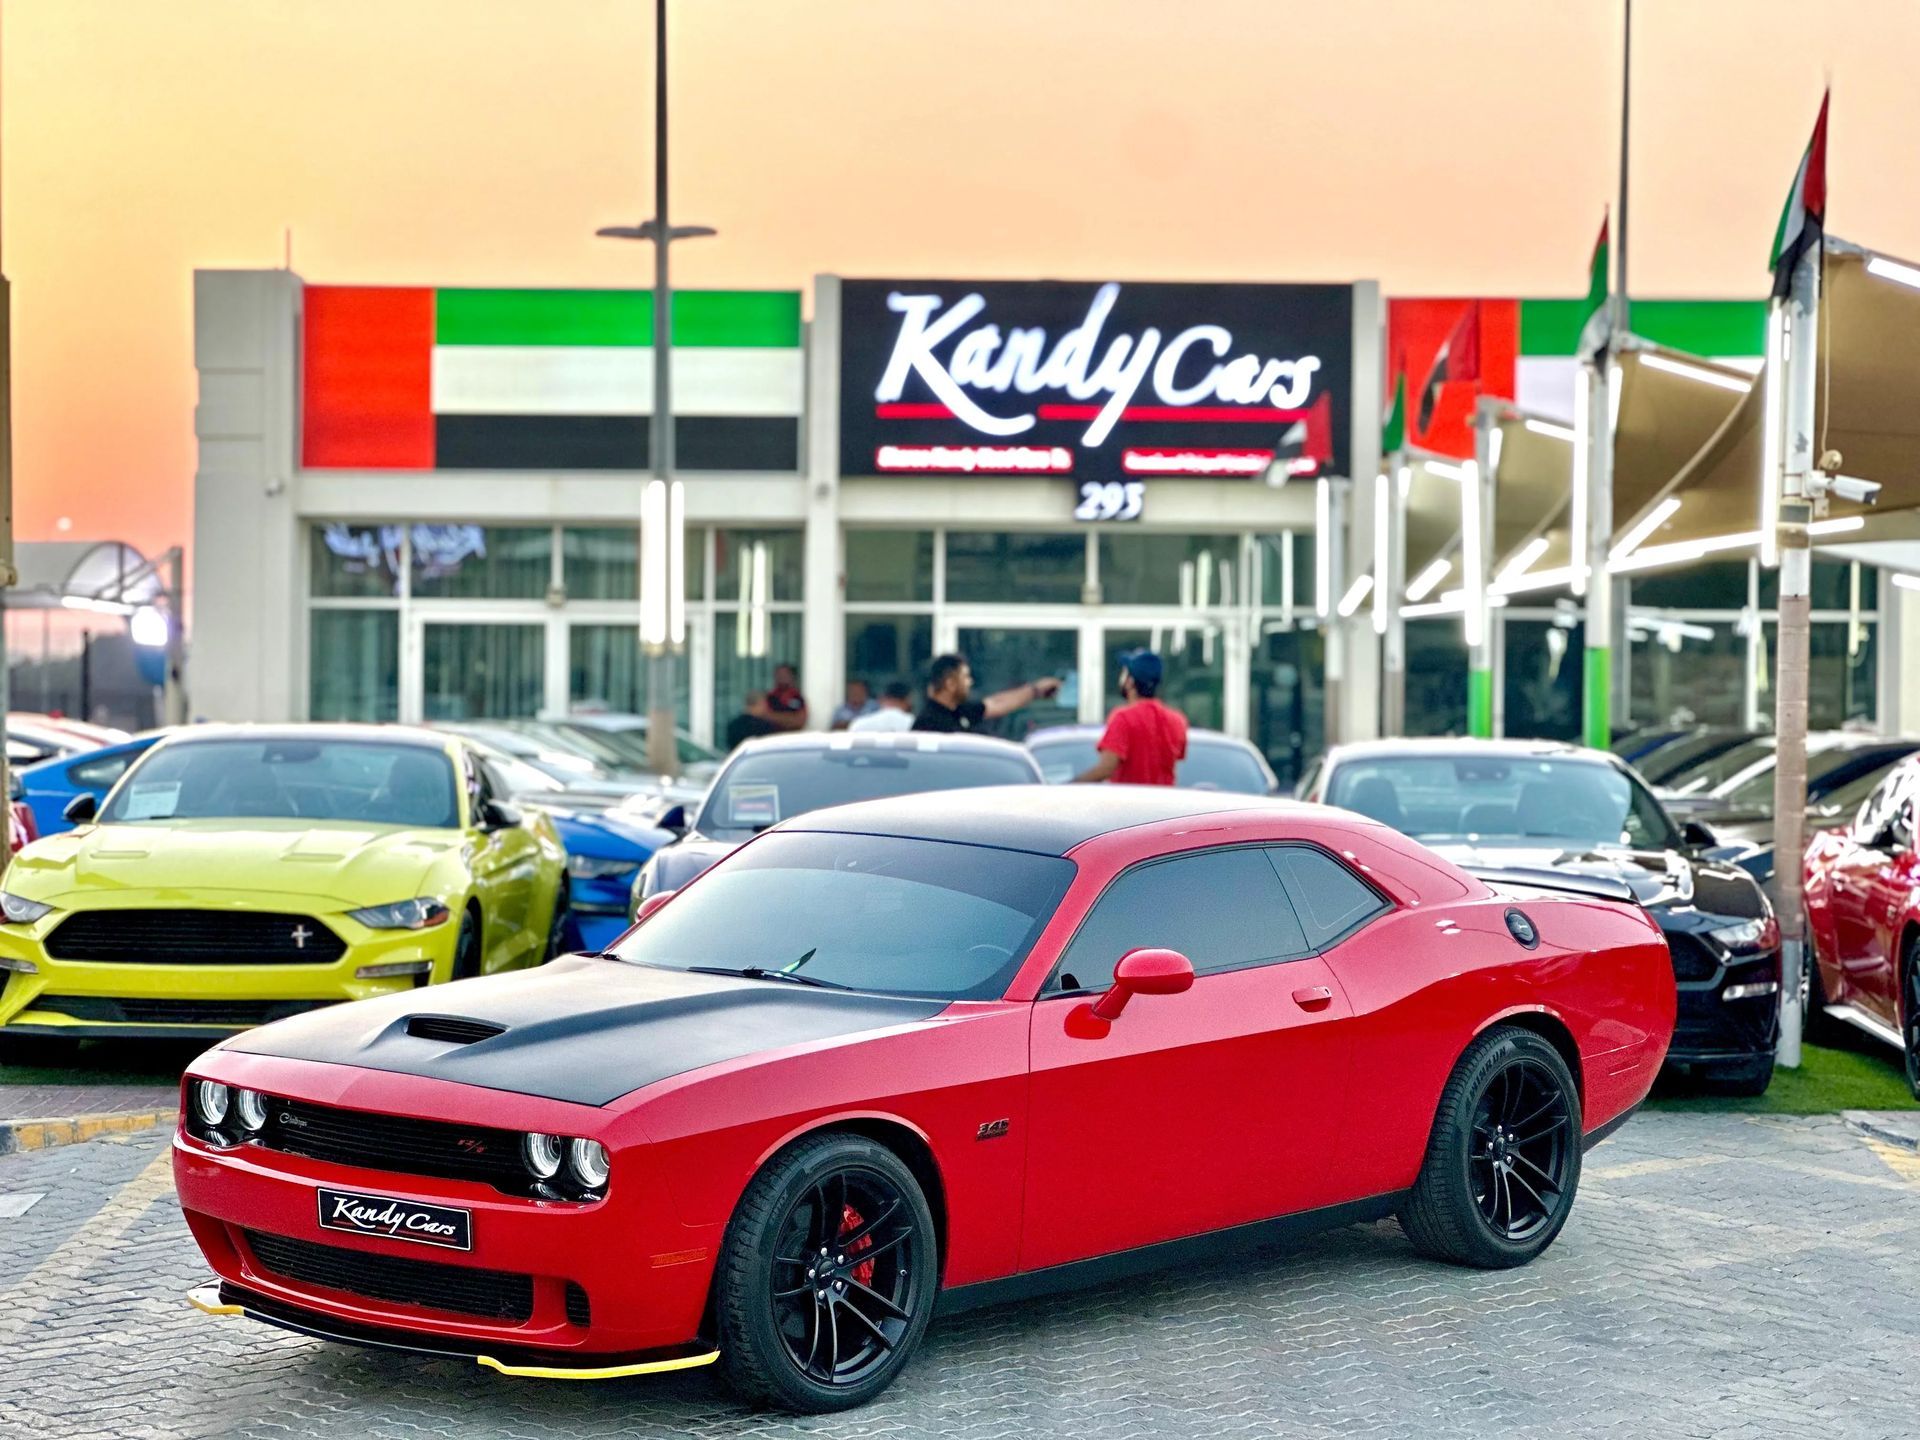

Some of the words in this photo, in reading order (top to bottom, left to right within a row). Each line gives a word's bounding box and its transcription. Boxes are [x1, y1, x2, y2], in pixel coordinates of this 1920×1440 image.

[875, 282, 1162, 447] Kandy
[1153, 325, 1321, 410] Cars
[1074, 481, 1145, 520] 295
[333, 1196, 405, 1234] Kandy
[405, 1213, 457, 1235] Cars
